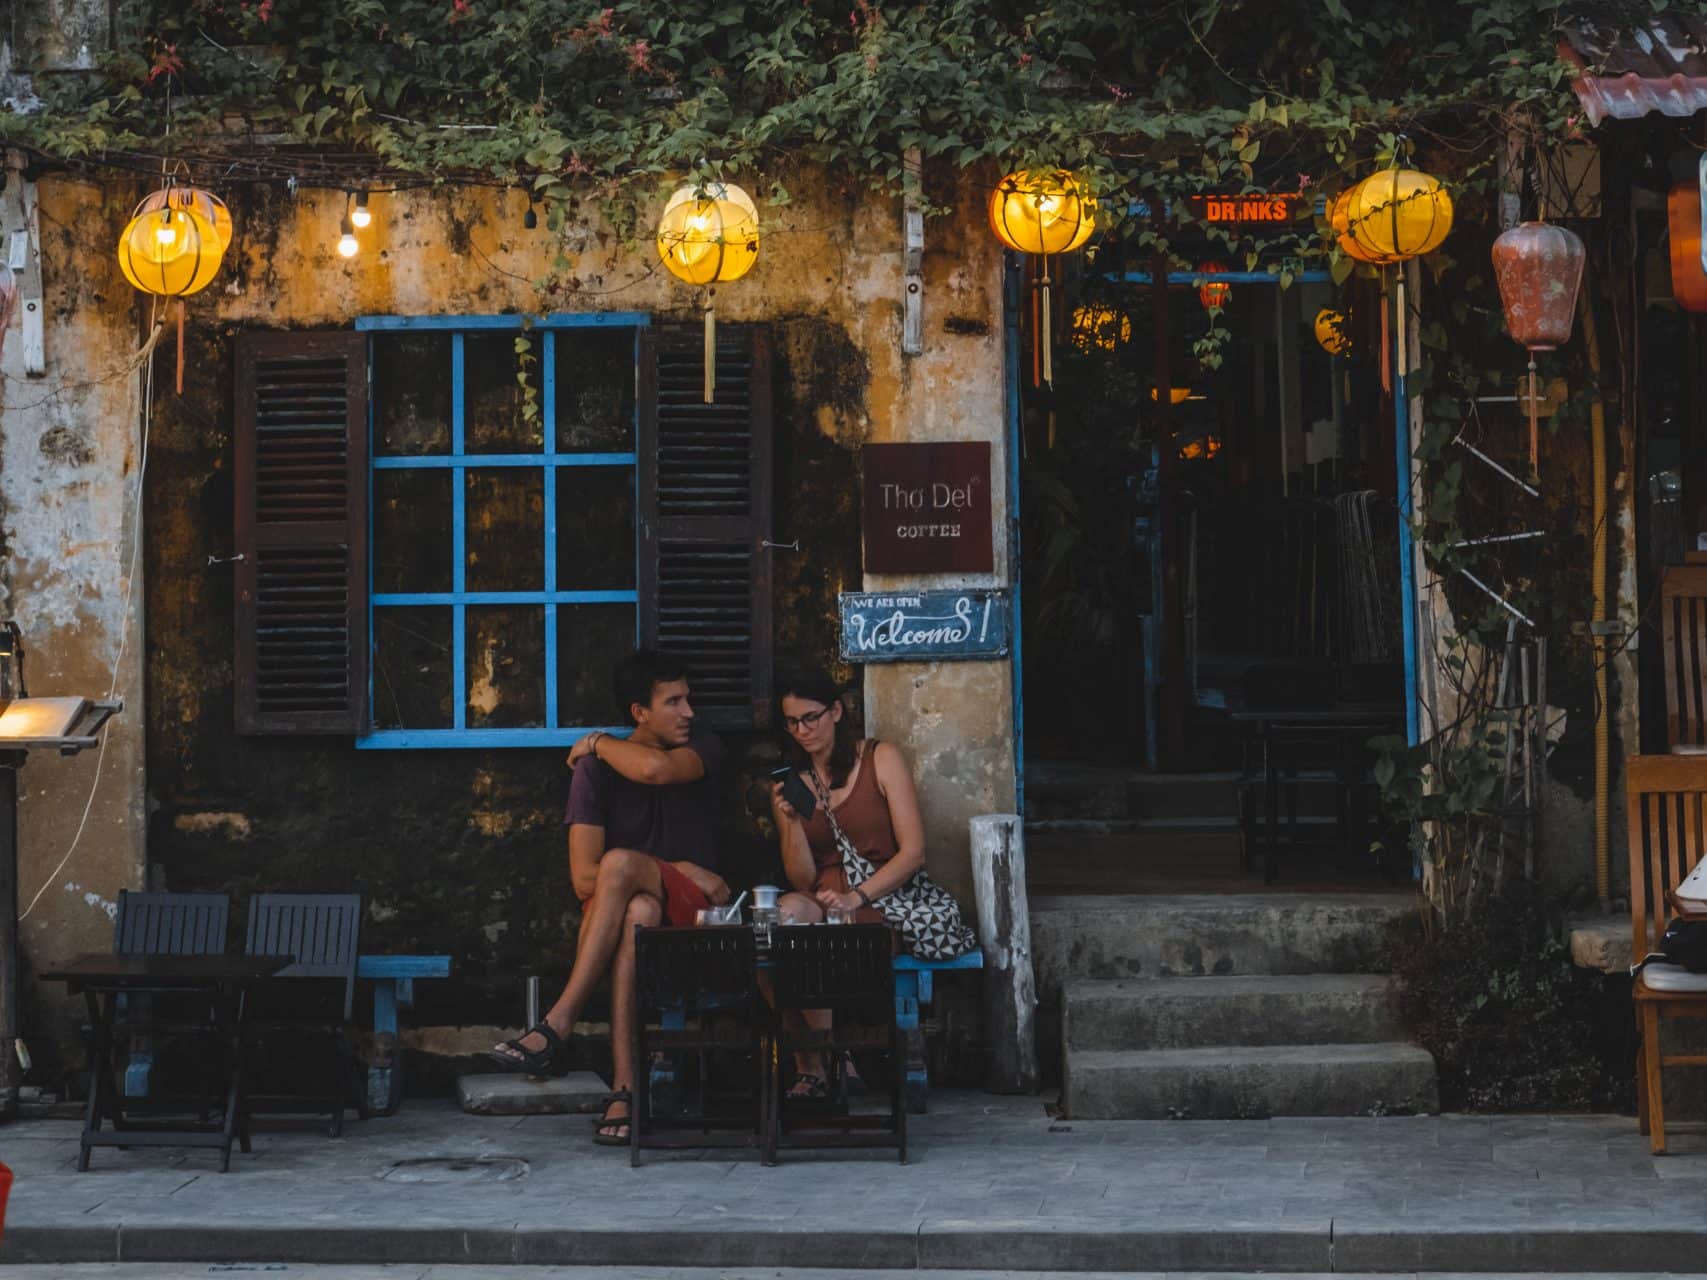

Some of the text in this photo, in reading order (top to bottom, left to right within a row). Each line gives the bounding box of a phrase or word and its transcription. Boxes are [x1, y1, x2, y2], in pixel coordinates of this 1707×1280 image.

[1207, 201, 1287, 222] DRNKS
[896, 524, 960, 538] COFFEE
[853, 597, 921, 609] WE ARE OPEN
